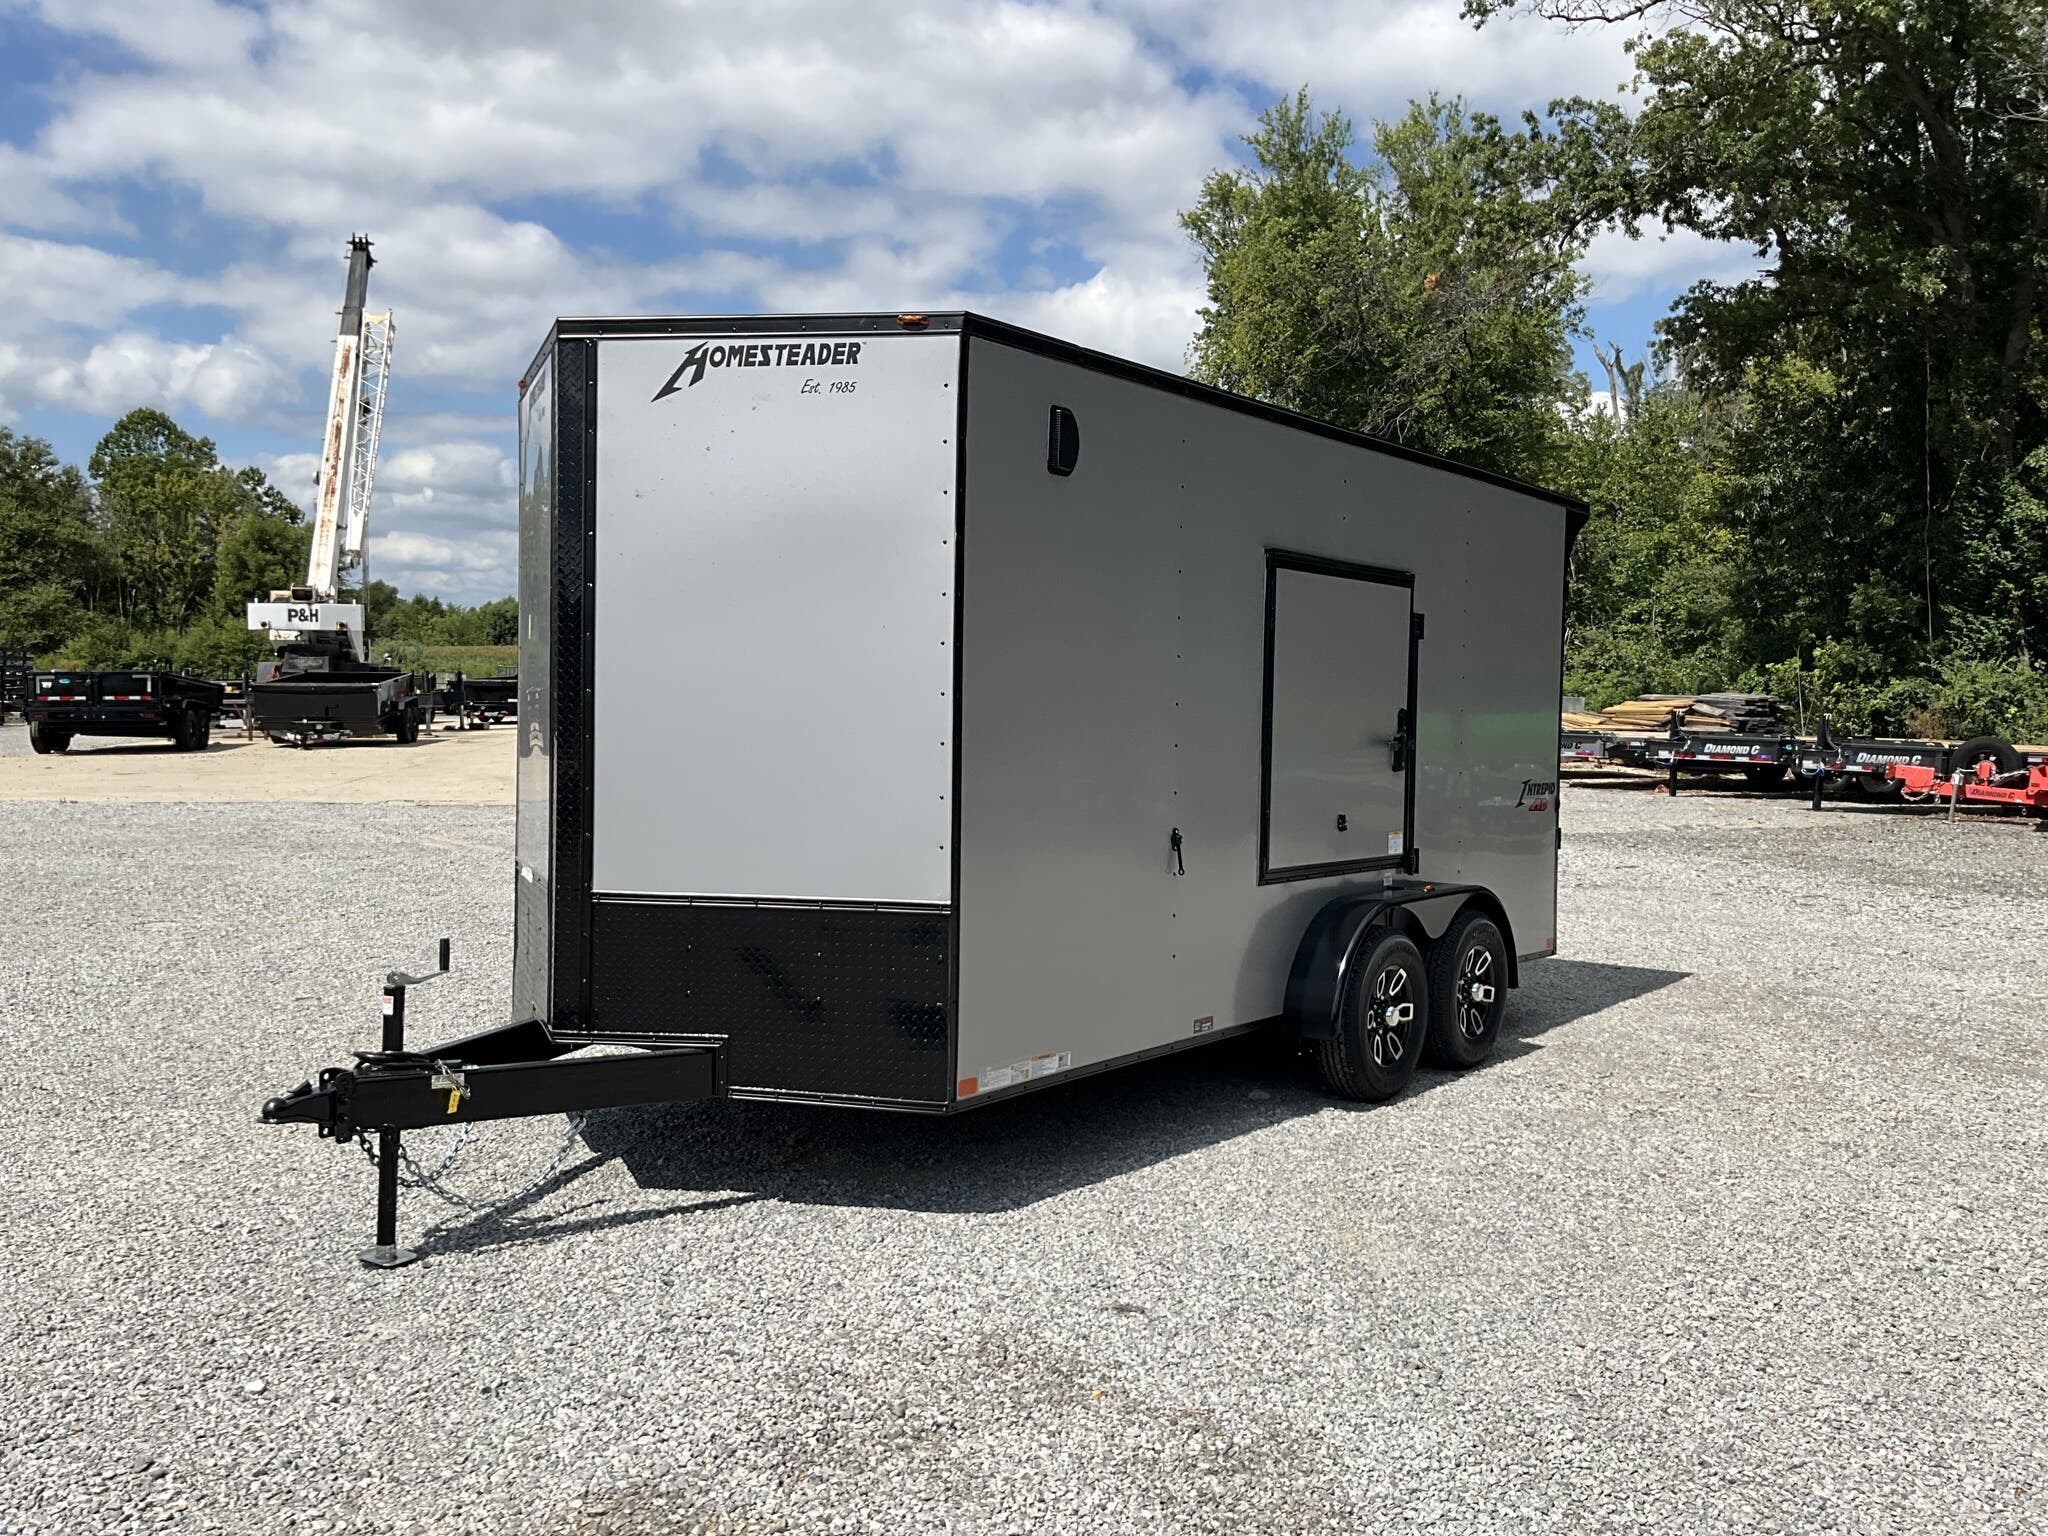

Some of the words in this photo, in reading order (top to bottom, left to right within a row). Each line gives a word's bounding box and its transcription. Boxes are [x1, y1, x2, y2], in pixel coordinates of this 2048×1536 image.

[651, 341, 861, 402] HOMESTEADER
[801, 378, 821, 394] Est.
[829, 381, 857, 394] 1985
[287, 608, 319, 622] P&H
[1704, 743, 1750, 755] DIAMOND
[1750, 745, 1761, 755] C
[1856, 752, 1910, 765] DIAMOND
[1911, 755, 1922, 766] C
[1515, 778, 1556, 808] INTREPID
[1971, 788, 2008, 798] DIAMOND
